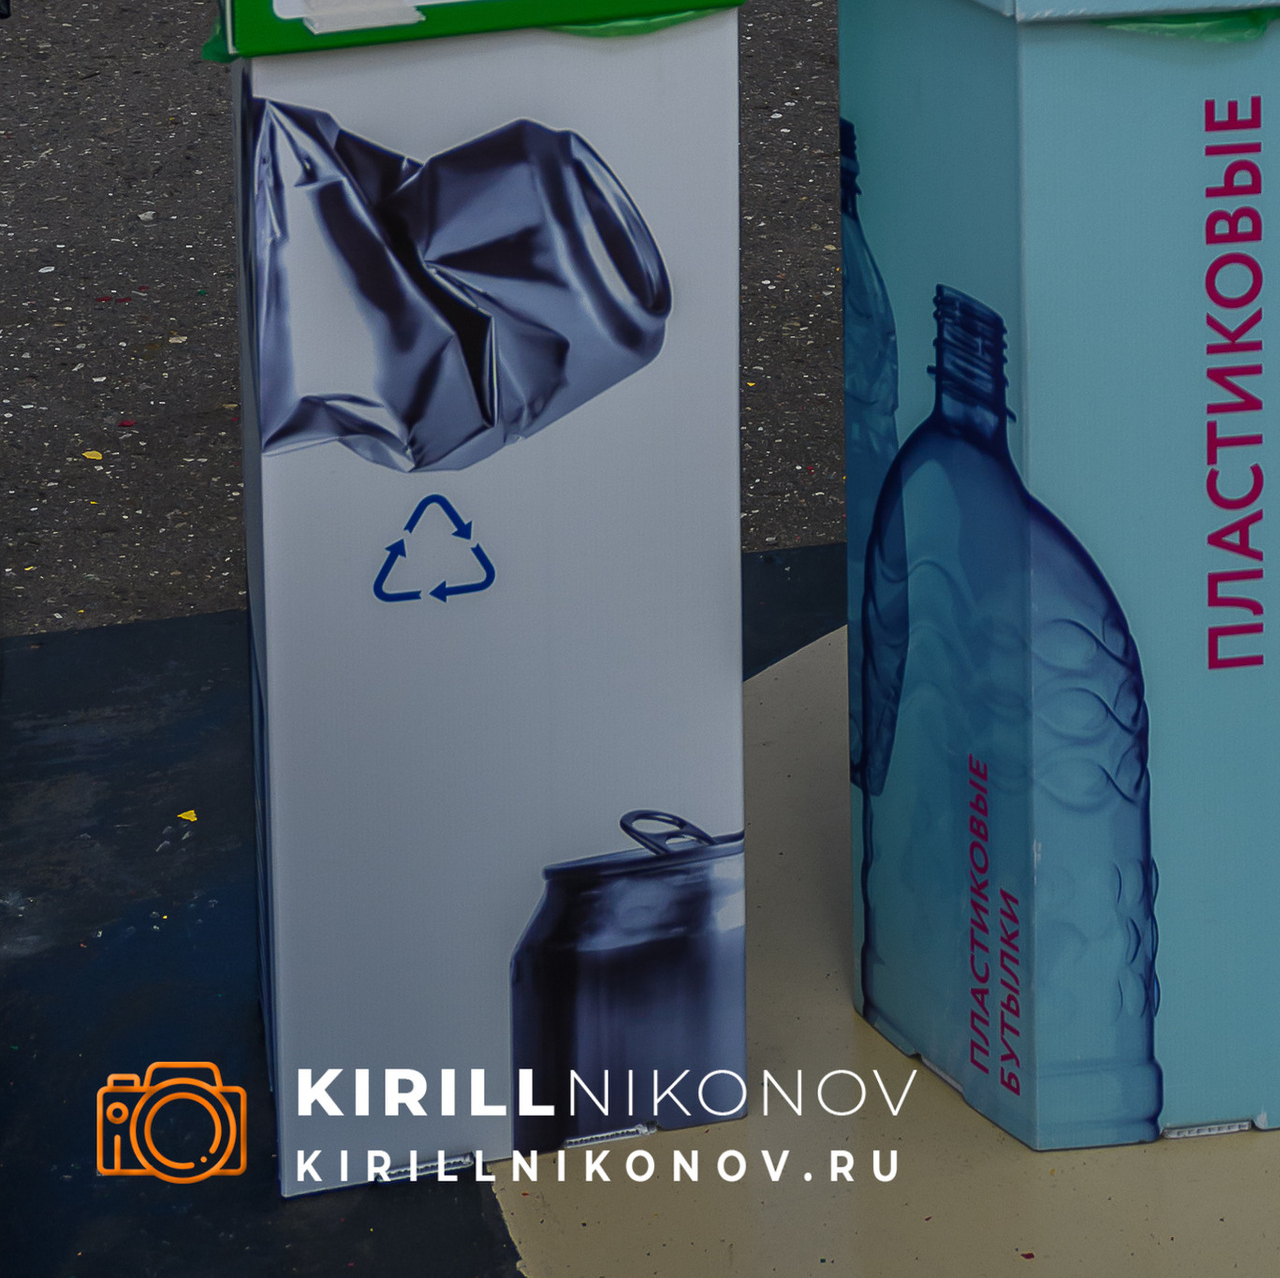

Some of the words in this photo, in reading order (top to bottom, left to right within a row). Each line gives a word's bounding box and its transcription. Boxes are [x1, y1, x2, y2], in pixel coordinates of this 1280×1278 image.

[1203, 94, 1265, 671] ПЛАСТИКОВЫЕ
[968, 752, 990, 1076] ПЛАСТИКОВЫЕ
[998, 886, 1021, 1097] БУТЫЛКИ
